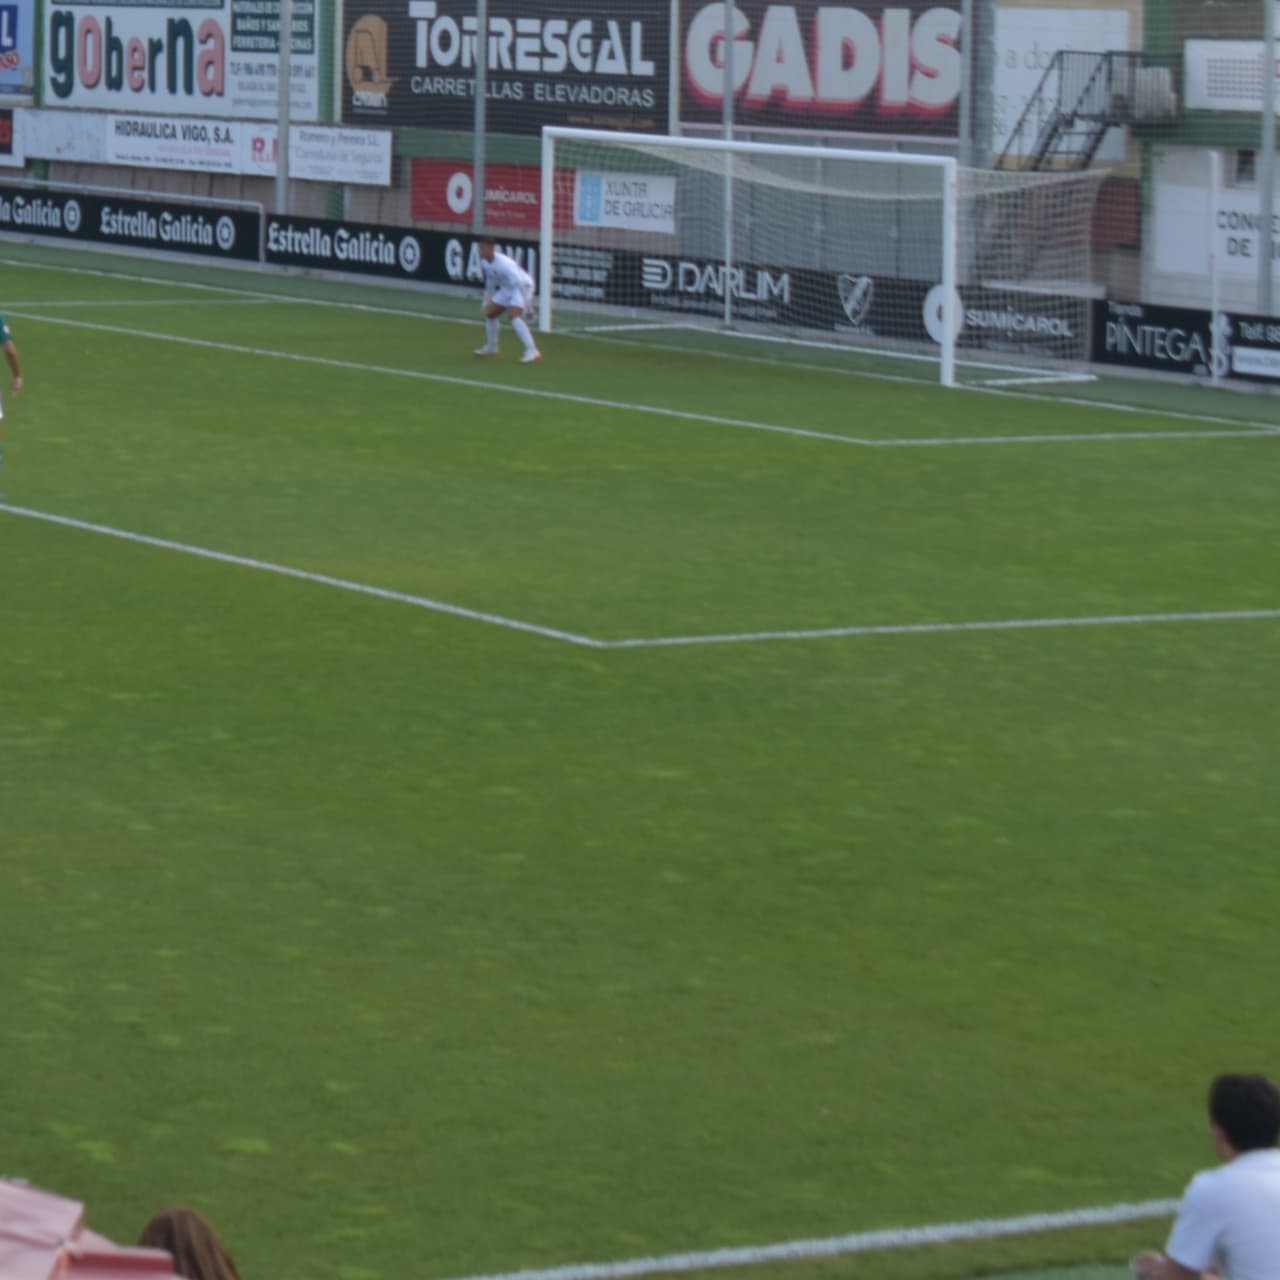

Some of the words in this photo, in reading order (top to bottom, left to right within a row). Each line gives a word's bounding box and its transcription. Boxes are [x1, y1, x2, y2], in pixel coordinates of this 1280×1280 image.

[1, 9, 14, 48] L
[49, 9, 226, 100] goberna
[685, 1, 963, 113] GADIS
[410, 76, 525, 101] CARRETLLAS
[533, 82, 656, 108] ELEVADORAS
[114, 120, 178, 140] HIDRAULICA
[181, 123, 211, 144] VIGO,
[214, 126, 234, 144] S.A.
[482, 186, 538, 206] UMICAROL
[604, 180, 648, 198] XUNTA
[11, 195, 62, 228] Galicia
[604, 199, 623, 217] DE
[623, 200, 674, 219] GALICIA
[99, 205, 157, 240] Estrella
[158, 209, 214, 246] Galicia
[267, 221, 332, 258] Estrella
[333, 227, 396, 265] Galicia
[1226, 236, 1252, 258] DE
